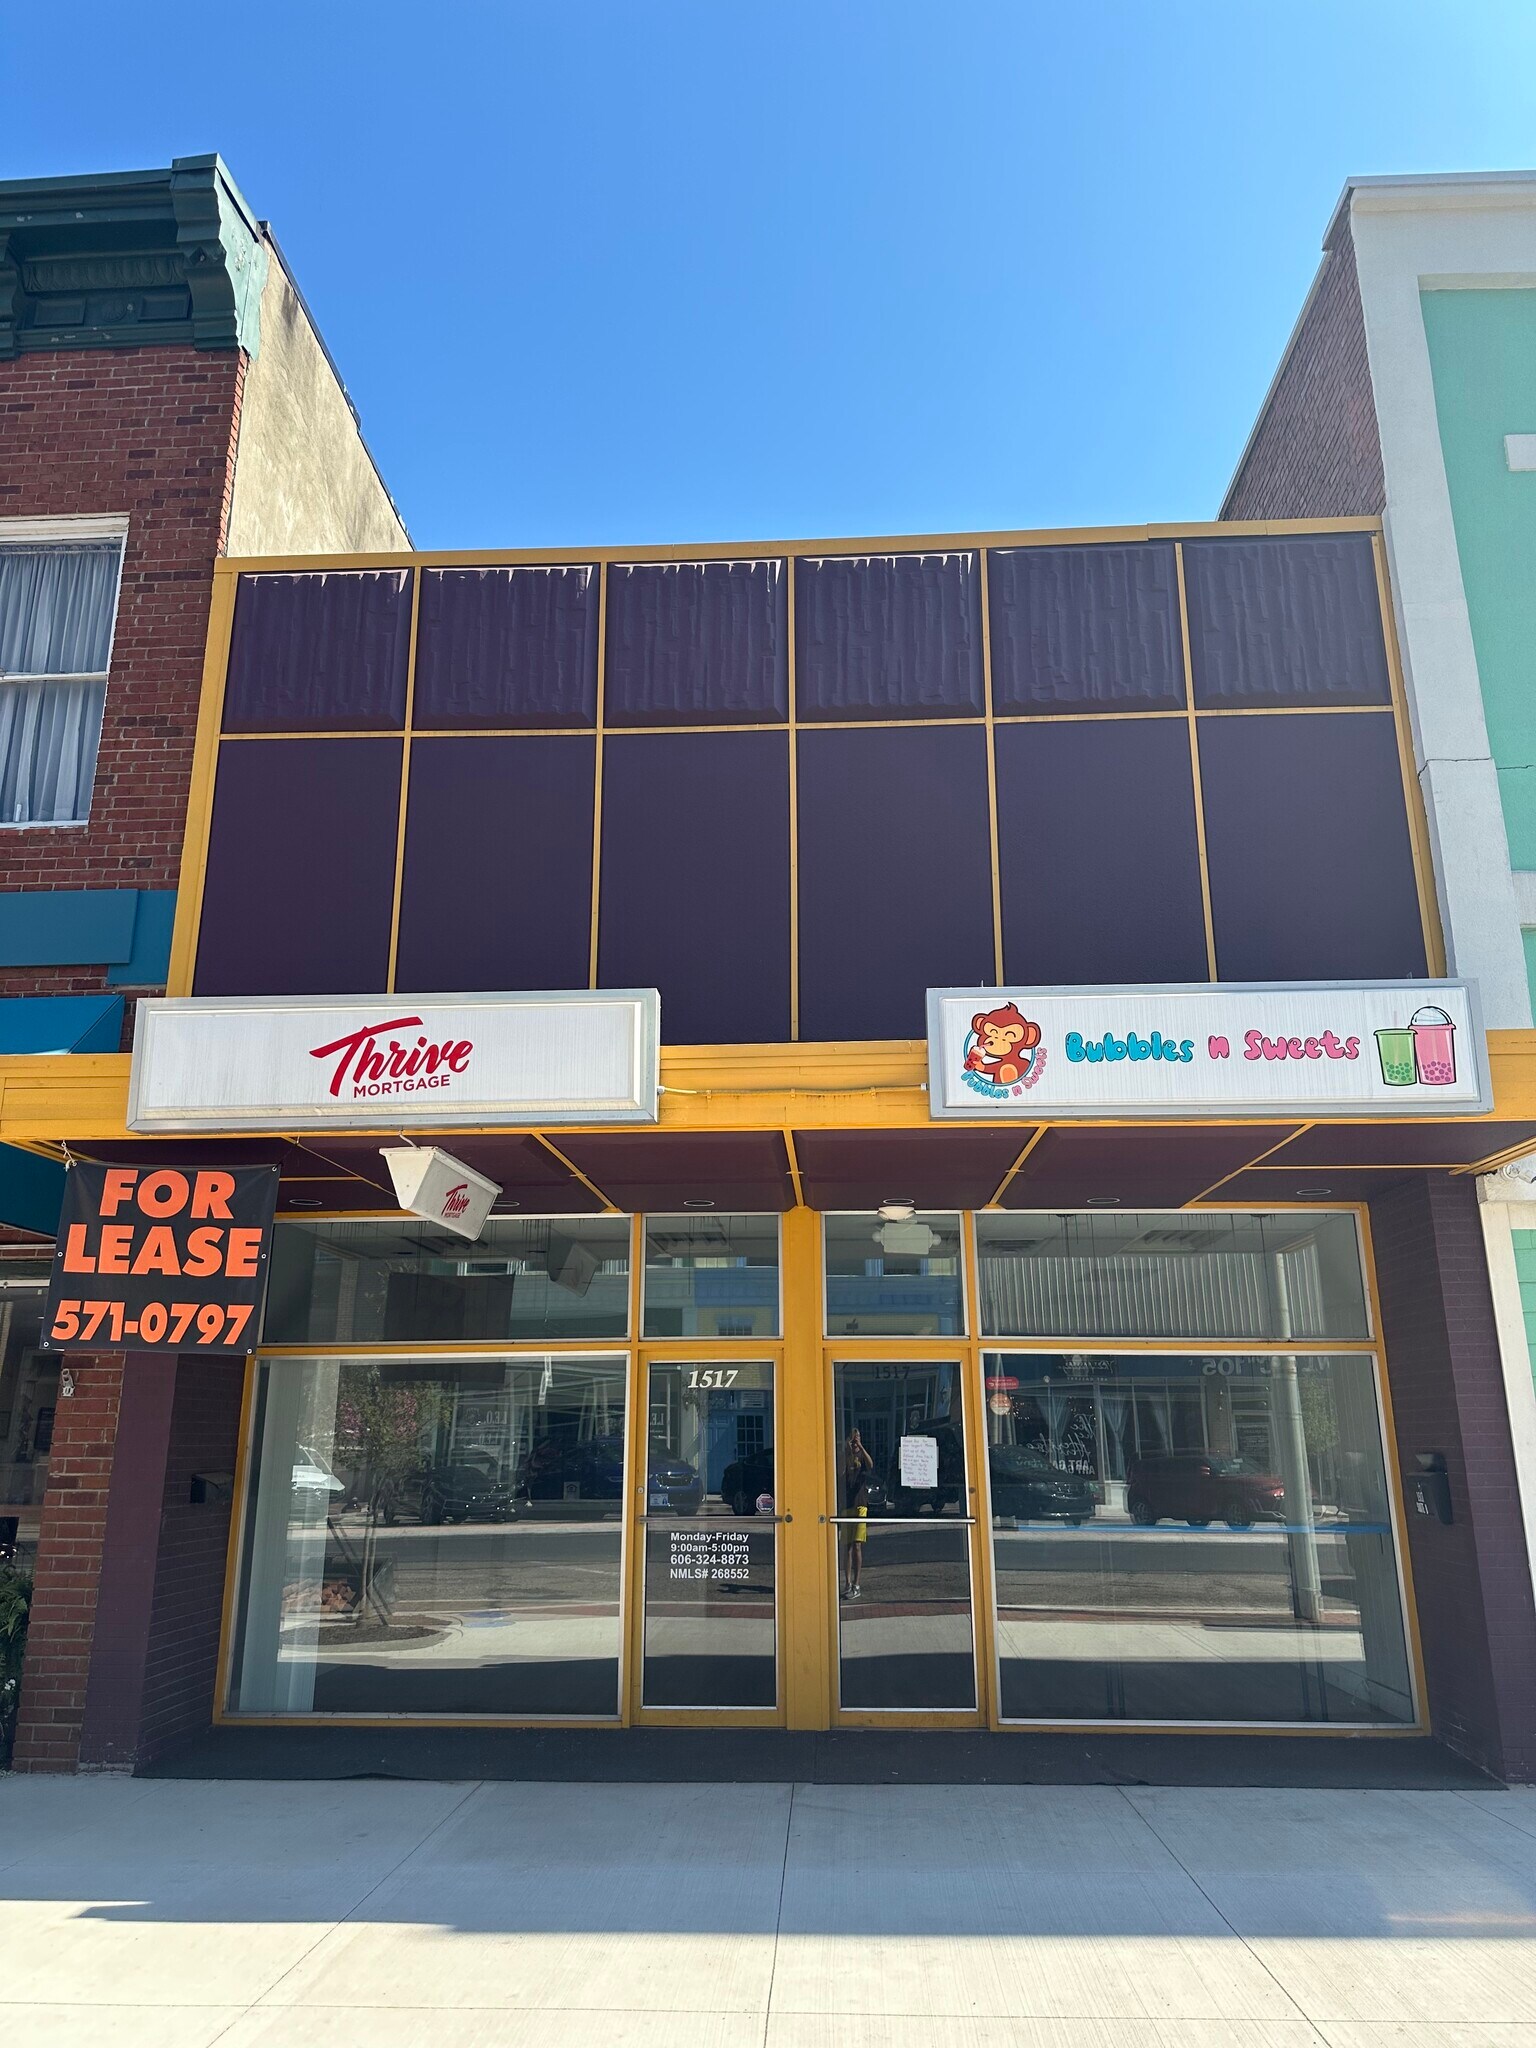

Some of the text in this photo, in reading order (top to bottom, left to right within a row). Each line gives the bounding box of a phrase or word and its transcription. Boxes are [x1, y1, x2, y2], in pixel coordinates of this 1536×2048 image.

[309, 1016, 473, 1096] Thrive
[1065, 1029, 1360, 1063] Bubbles n Sweets
[353, 1074, 450, 1098] MORTGAGE
[100, 1169, 236, 1219] FOR
[441, 1183, 470, 1215] Thrive
[63, 1224, 263, 1277] LEASE
[51, 1300, 254, 1345] 571-0797
[688, 1369, 739, 1388] 1517
[875, 1366, 910, 1379] 1517
[670, 1532, 749, 1543] Monday-Friday
[670, 1543, 750, 1554] 9:00am-5:00pm
[670, 1554, 750, 1565] 606-324-8873
[670, 1568, 750, 1579] NMLS# 268552
